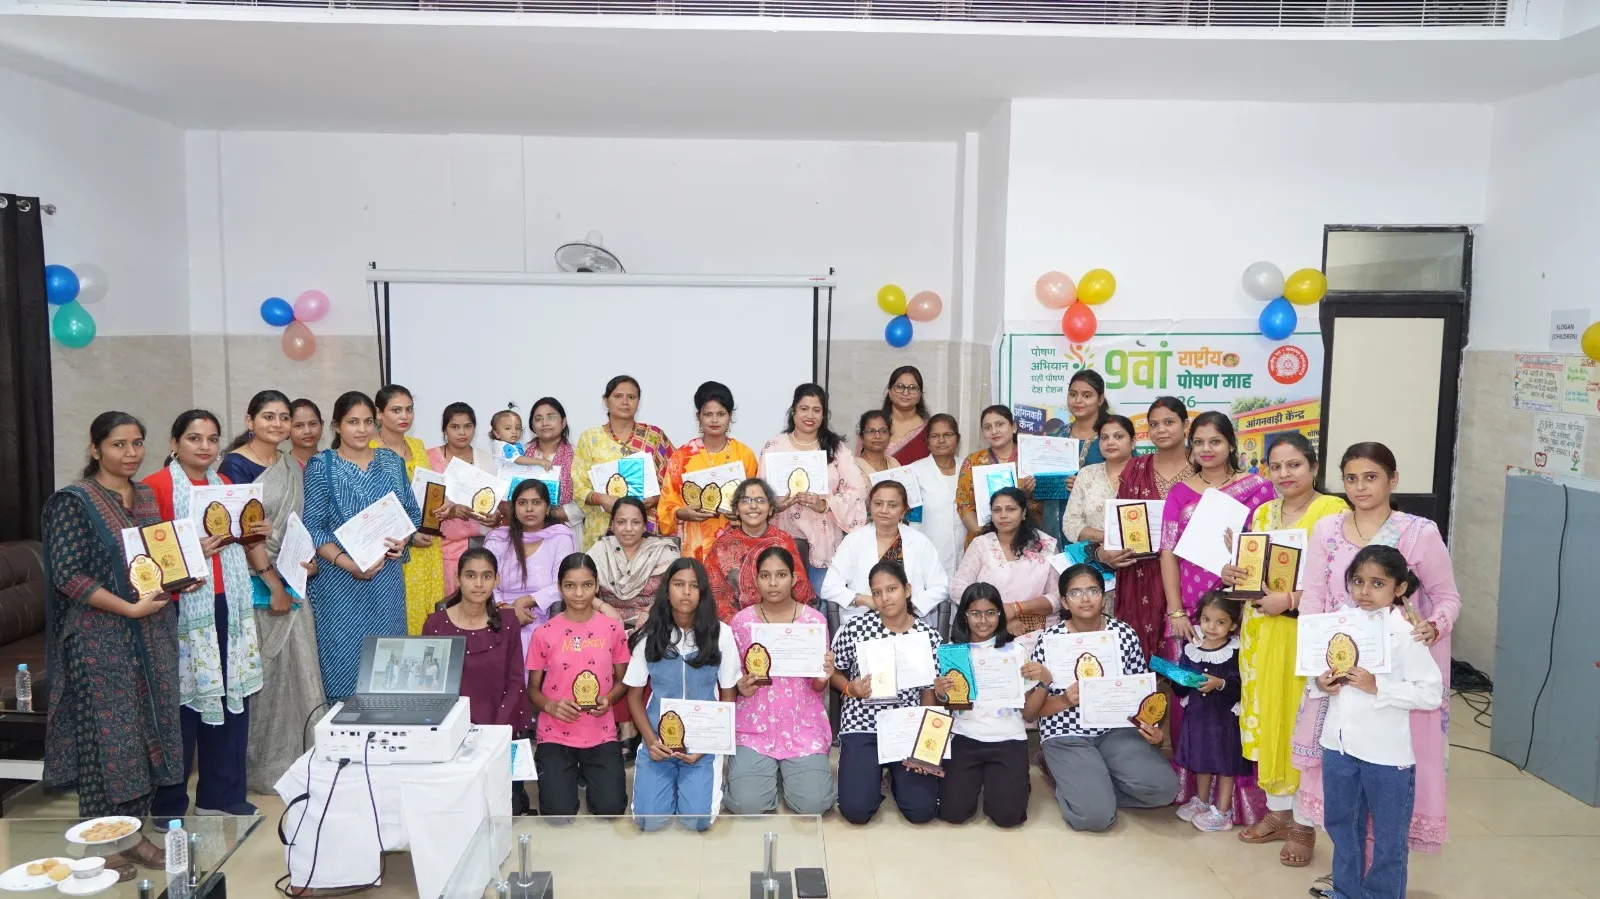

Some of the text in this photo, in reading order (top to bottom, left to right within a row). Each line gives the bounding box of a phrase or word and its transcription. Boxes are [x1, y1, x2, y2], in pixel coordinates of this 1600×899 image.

[1556, 323, 1575, 331] SLOGAN
[1551, 333, 1578, 341] (CHILDREN)
[1031, 345, 1056, 357] पोषण
[1177, 346, 1223, 369] राष्ट्रीय
[1031, 359, 1069, 371] अभियान
[1045, 373, 1064, 382] पोषण
[1177, 370, 1253, 389] पोषण माह
[1031, 384, 1043, 394] देश
[1014, 406, 1043, 422] आंगनवाड़ी
[1246, 412, 1283, 428] आंगनवाड़ी
